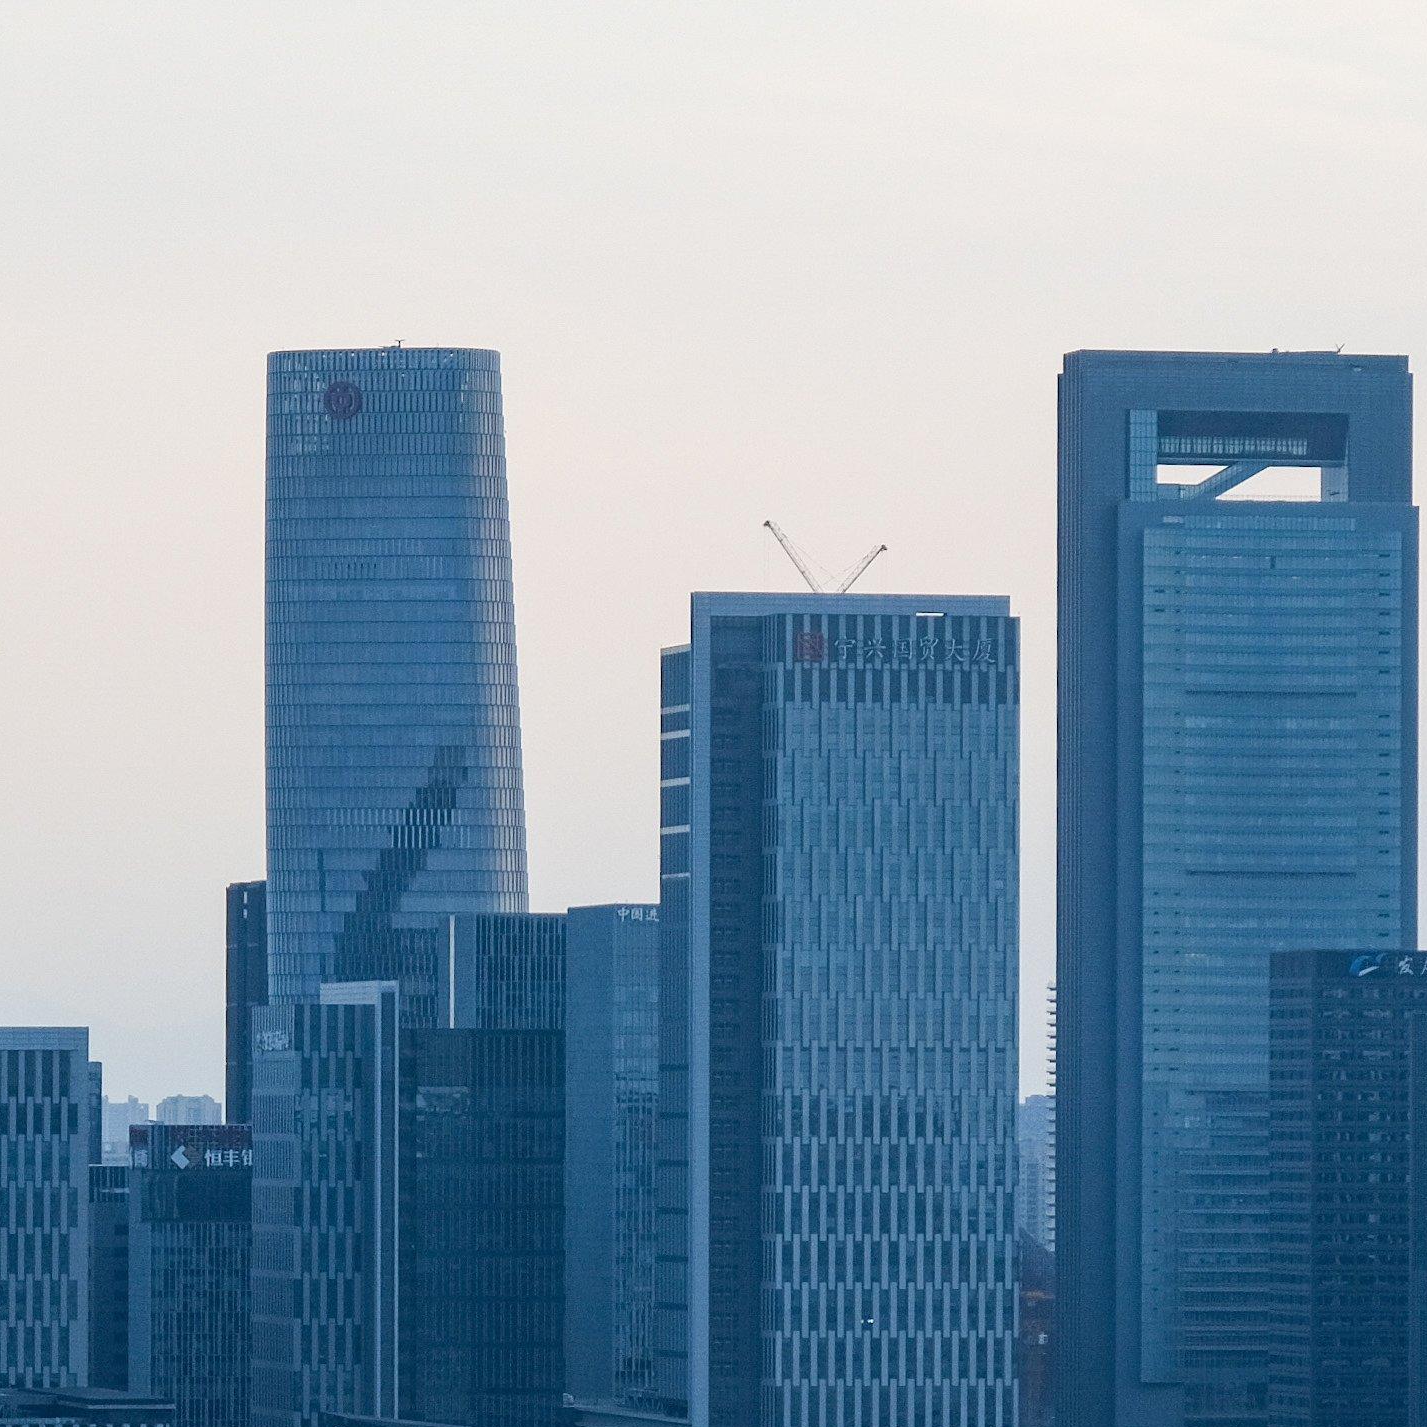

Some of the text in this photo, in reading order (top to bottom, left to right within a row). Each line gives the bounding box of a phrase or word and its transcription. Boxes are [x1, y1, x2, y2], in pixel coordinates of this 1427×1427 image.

[834, 636, 996, 663] 宁兴国贸大厦
